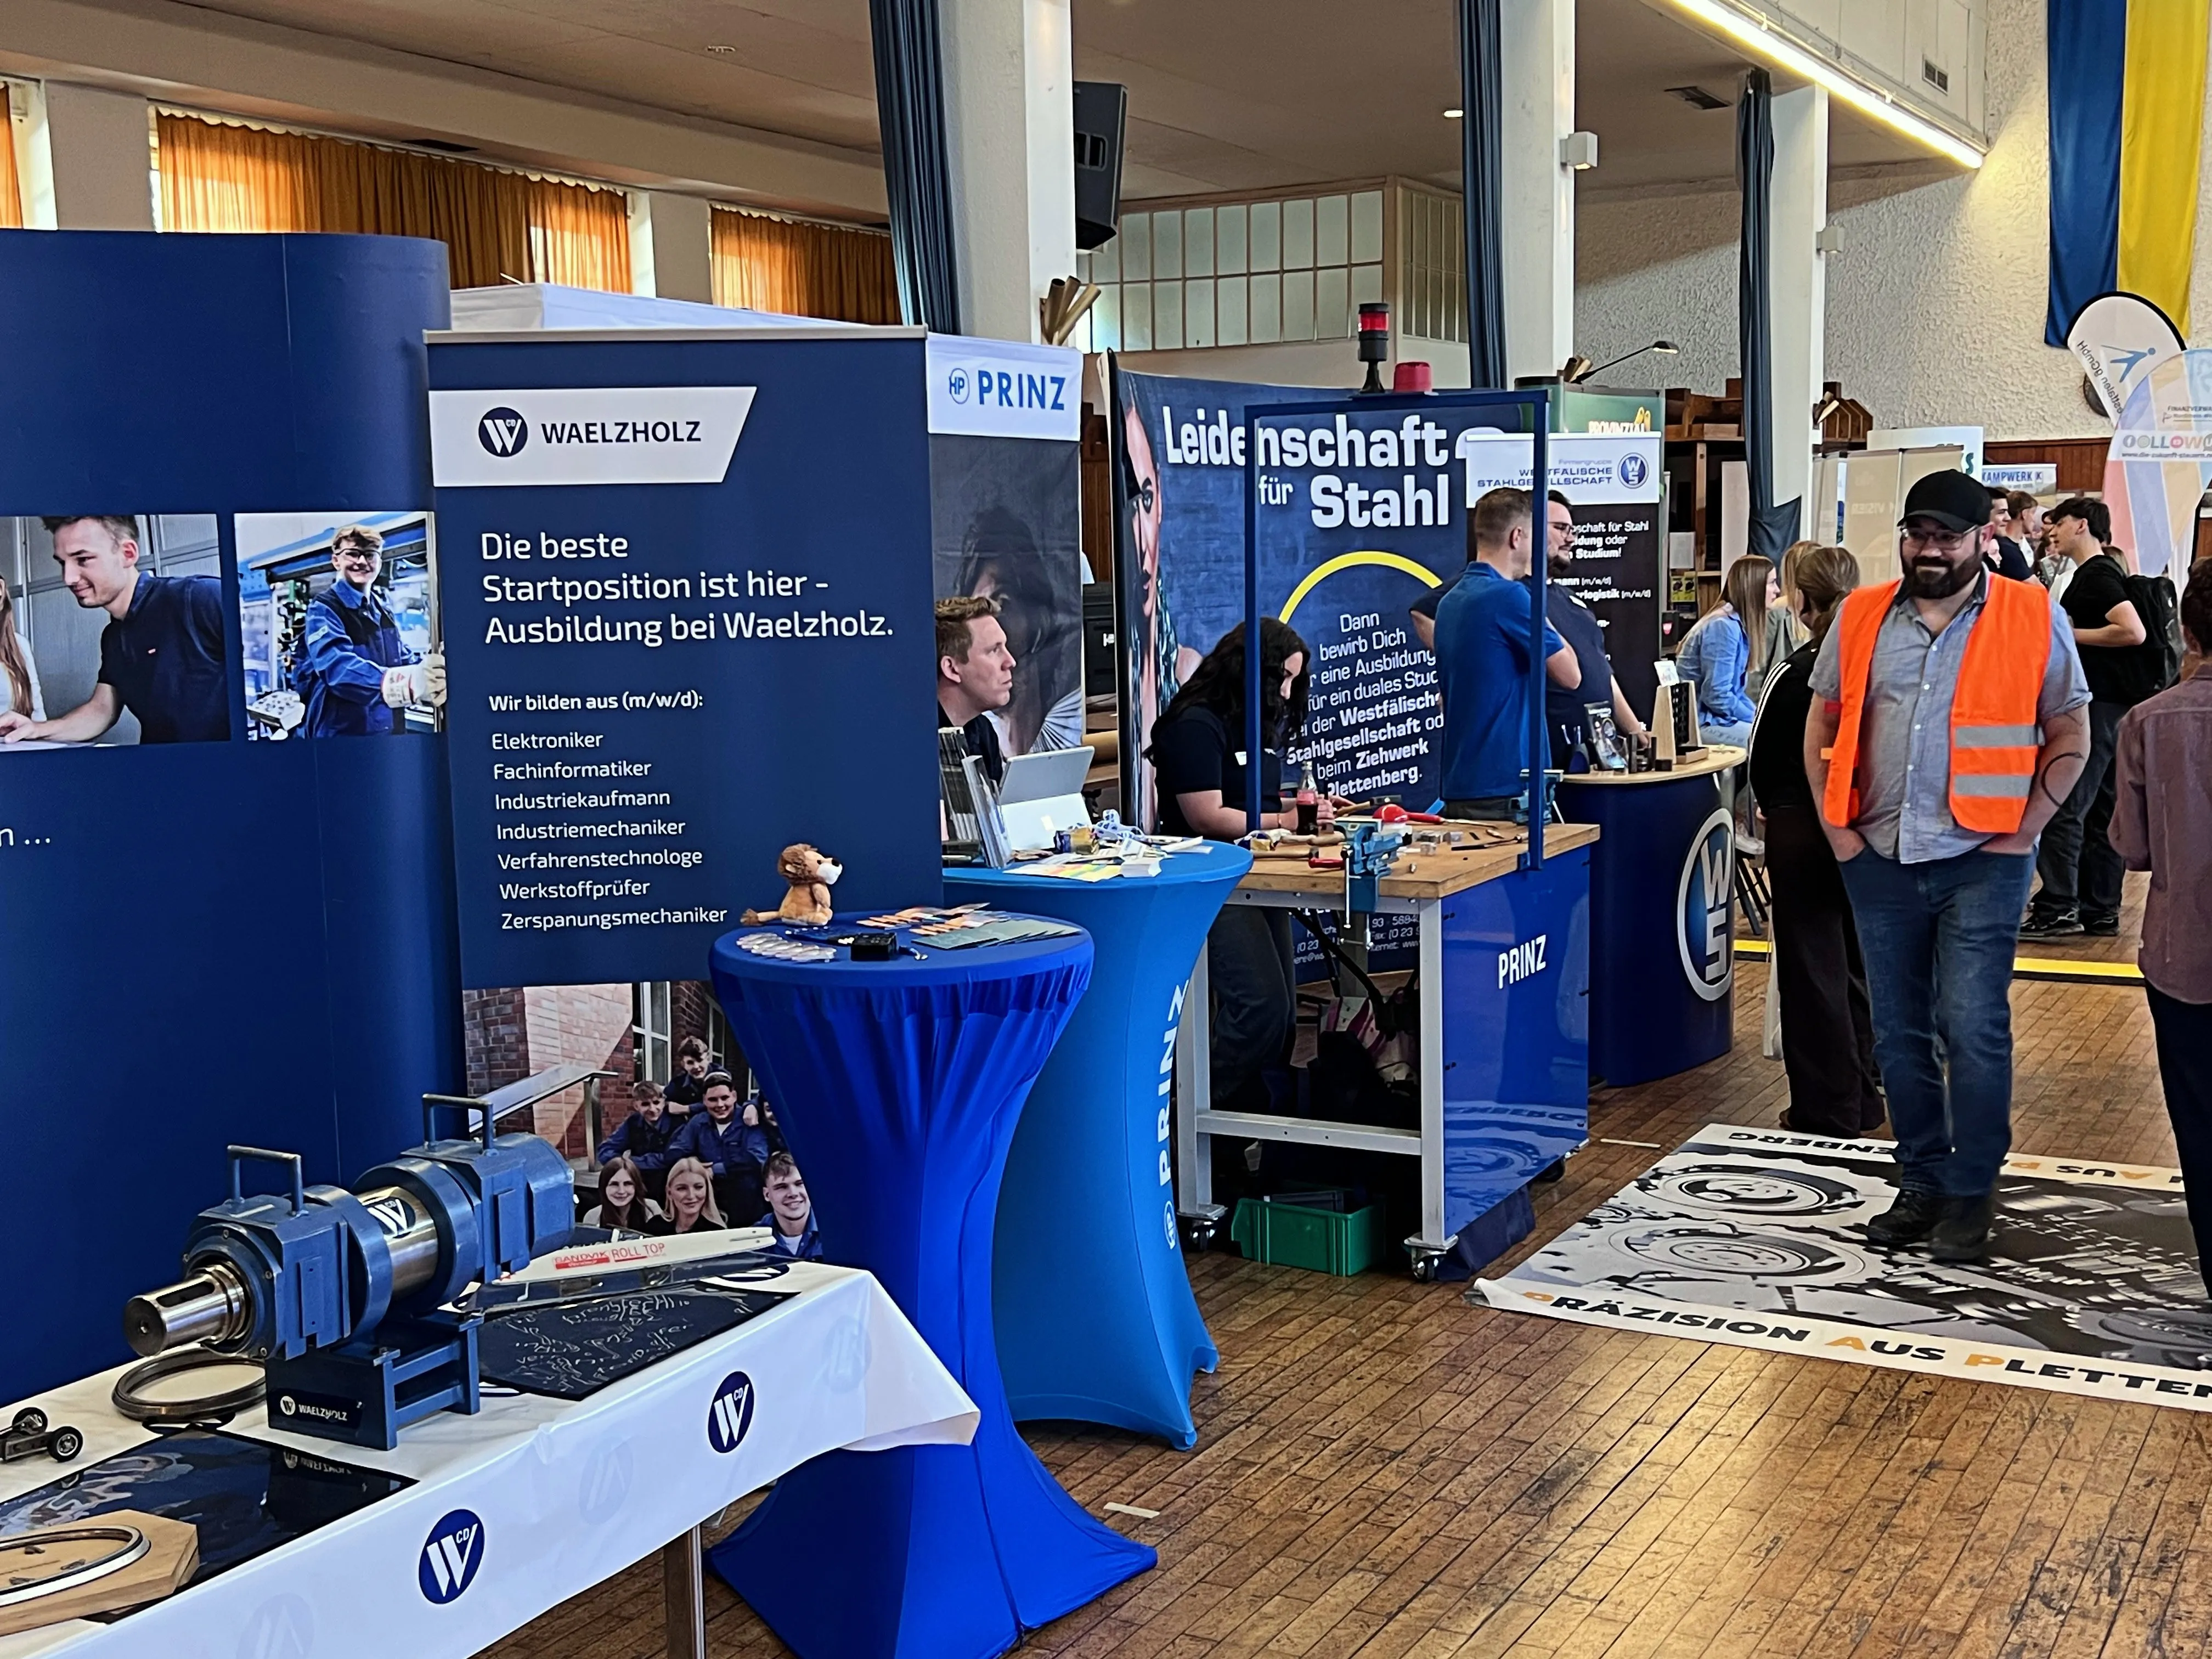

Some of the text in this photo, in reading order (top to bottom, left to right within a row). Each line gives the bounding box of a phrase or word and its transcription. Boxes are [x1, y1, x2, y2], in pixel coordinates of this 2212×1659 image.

[978, 369, 1066, 411] PRINZ
[541, 421, 702, 444] WAELZHOLZ
[1162, 405, 1449, 467] Leidenschaft
[1477, 477, 1612, 487] STAHLGELLSCHAFT
[1259, 474, 1449, 528] für Stahl
[1608, 521, 1623, 532] für
[1624, 520, 1649, 532] Stahl
[481, 532, 629, 560] Die beste
[1605, 534, 1628, 545] oder
[483, 573, 691, 606] Startposition
[699, 571, 740, 598] ist
[747, 569, 808, 597] hier
[485, 610, 894, 647] Ausbildung bei Waelzholz.
[1340, 613, 1380, 633] Dann
[1319, 628, 1406, 661] bewirb Dich
[1321, 665, 1351, 685] eine
[1355, 649, 1436, 678] Ausbildung
[488, 690, 704, 712] Wir bilden aus (m/w/d):
[1330, 688, 1351, 707] ein
[1353, 677, 1402, 703] duales
[1312, 716, 1336, 735] der
[492, 731, 603, 750] Elektroniker
[1286, 718, 1420, 765] Stahlgesellschaft
[493, 760, 652, 780] Fachinformatiker
[1317, 737, 1429, 780] beim Ziehwerk
[1327, 766, 1423, 797] Plettenberg.
[495, 790, 670, 810] Industriekaufmann
[496, 820, 686, 840] Industriemechaniker
[497, 848, 704, 870] Verfahrenstechnologe
[499, 879, 651, 900] Werkstoffprüfer
[501, 906, 728, 931] Zerspanungsmechaniker
[1498, 934, 1547, 990] PRINZ
[1158, 979, 1189, 1187] PRINZ
[611, 1246, 641, 1259] ROLL
[643, 1243, 665, 1255] TOP
[1522, 1291, 1810, 1342] PRÄZISION
[1823, 1335, 1946, 1362] AUS
[298, 1403, 348, 1421] WAELZHOLZ
